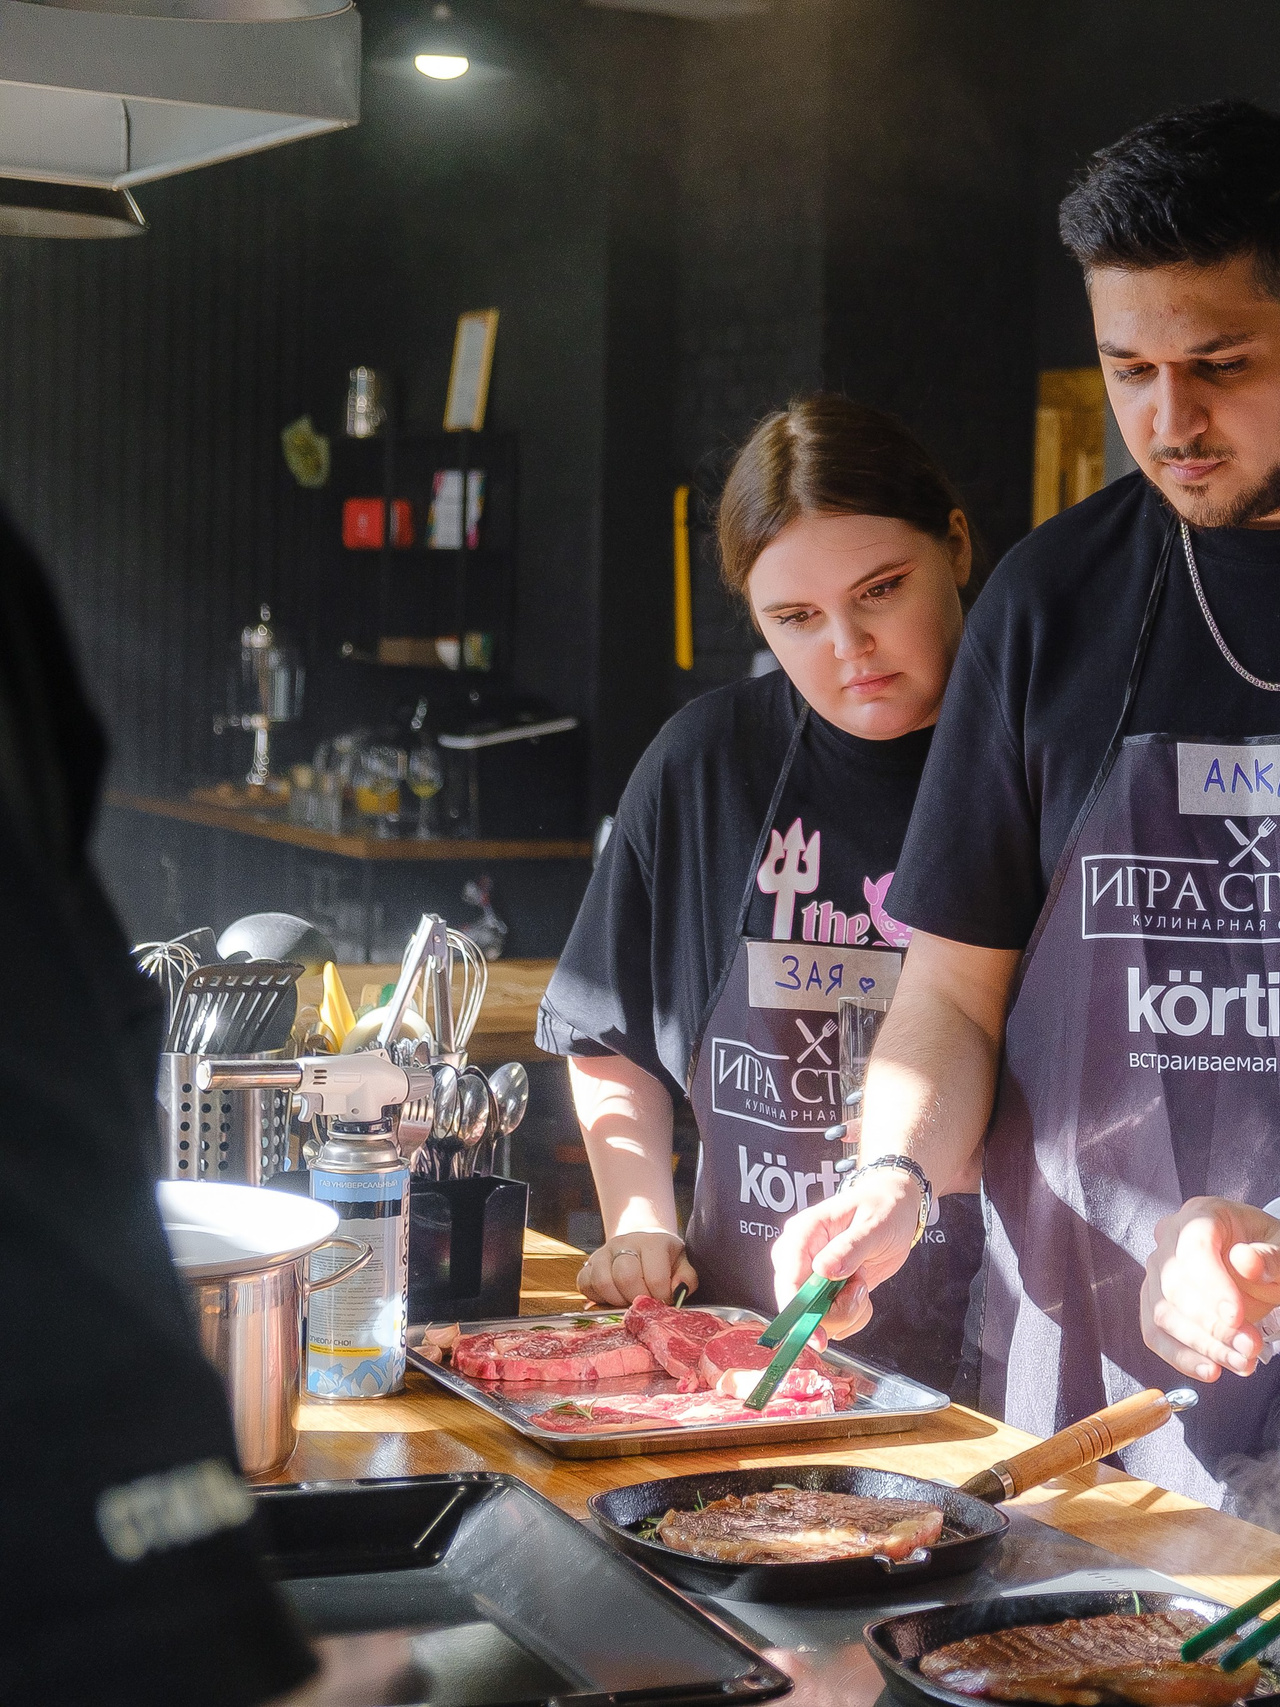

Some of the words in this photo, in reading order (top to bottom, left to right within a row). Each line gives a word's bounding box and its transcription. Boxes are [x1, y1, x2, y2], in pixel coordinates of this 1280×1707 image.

[1091, 866, 1207, 911] ИГРА
[801, 900, 871, 945] the
[1132, 914, 1267, 932] КУЛИНАРНАЯ
[775, 954, 844, 996] ЗАЯ
[718, 1048, 782, 1103] ИГРА
[1128, 1051, 1278, 1074] встраиваемая
[744, 1097, 838, 1122] КУЛИНАРНАЯ
[738, 1144, 841, 1214] kört
